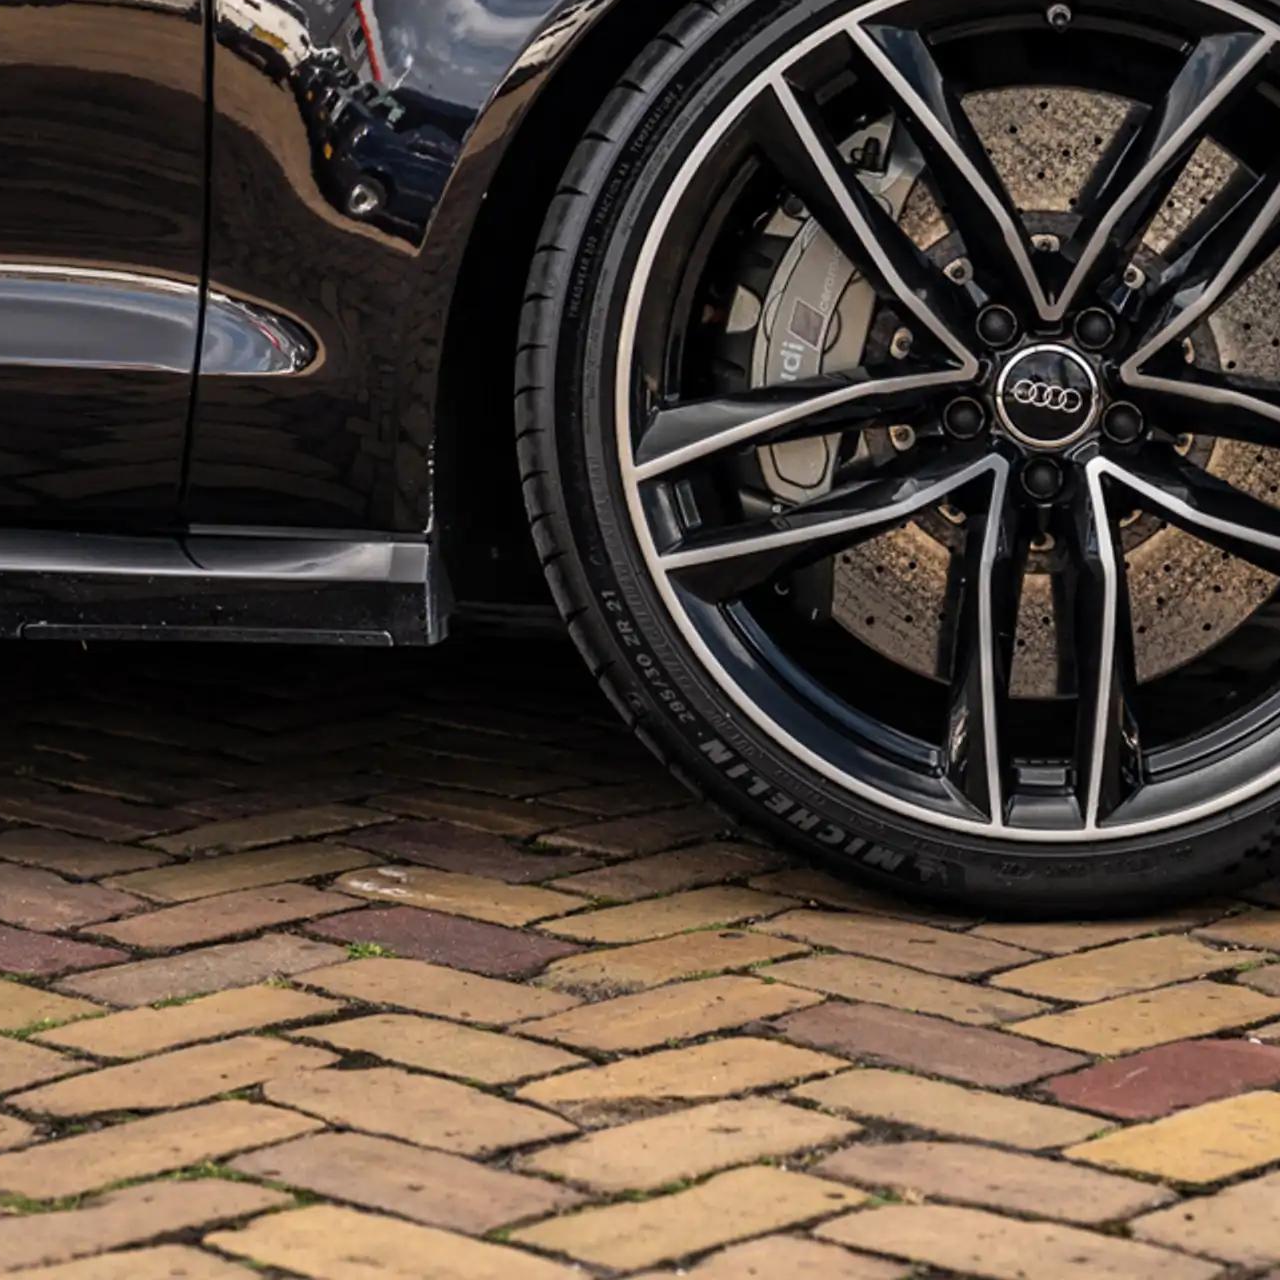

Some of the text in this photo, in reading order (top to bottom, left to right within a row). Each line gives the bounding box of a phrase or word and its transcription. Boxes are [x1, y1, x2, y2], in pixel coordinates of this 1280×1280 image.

[629, 91, 677, 153] TEMPERATURE
[600, 589, 623, 612] 21
[615, 619, 641, 647] ZR
[634, 652, 696, 724] 285/30
[698, 737, 905, 875] MICHELIN
